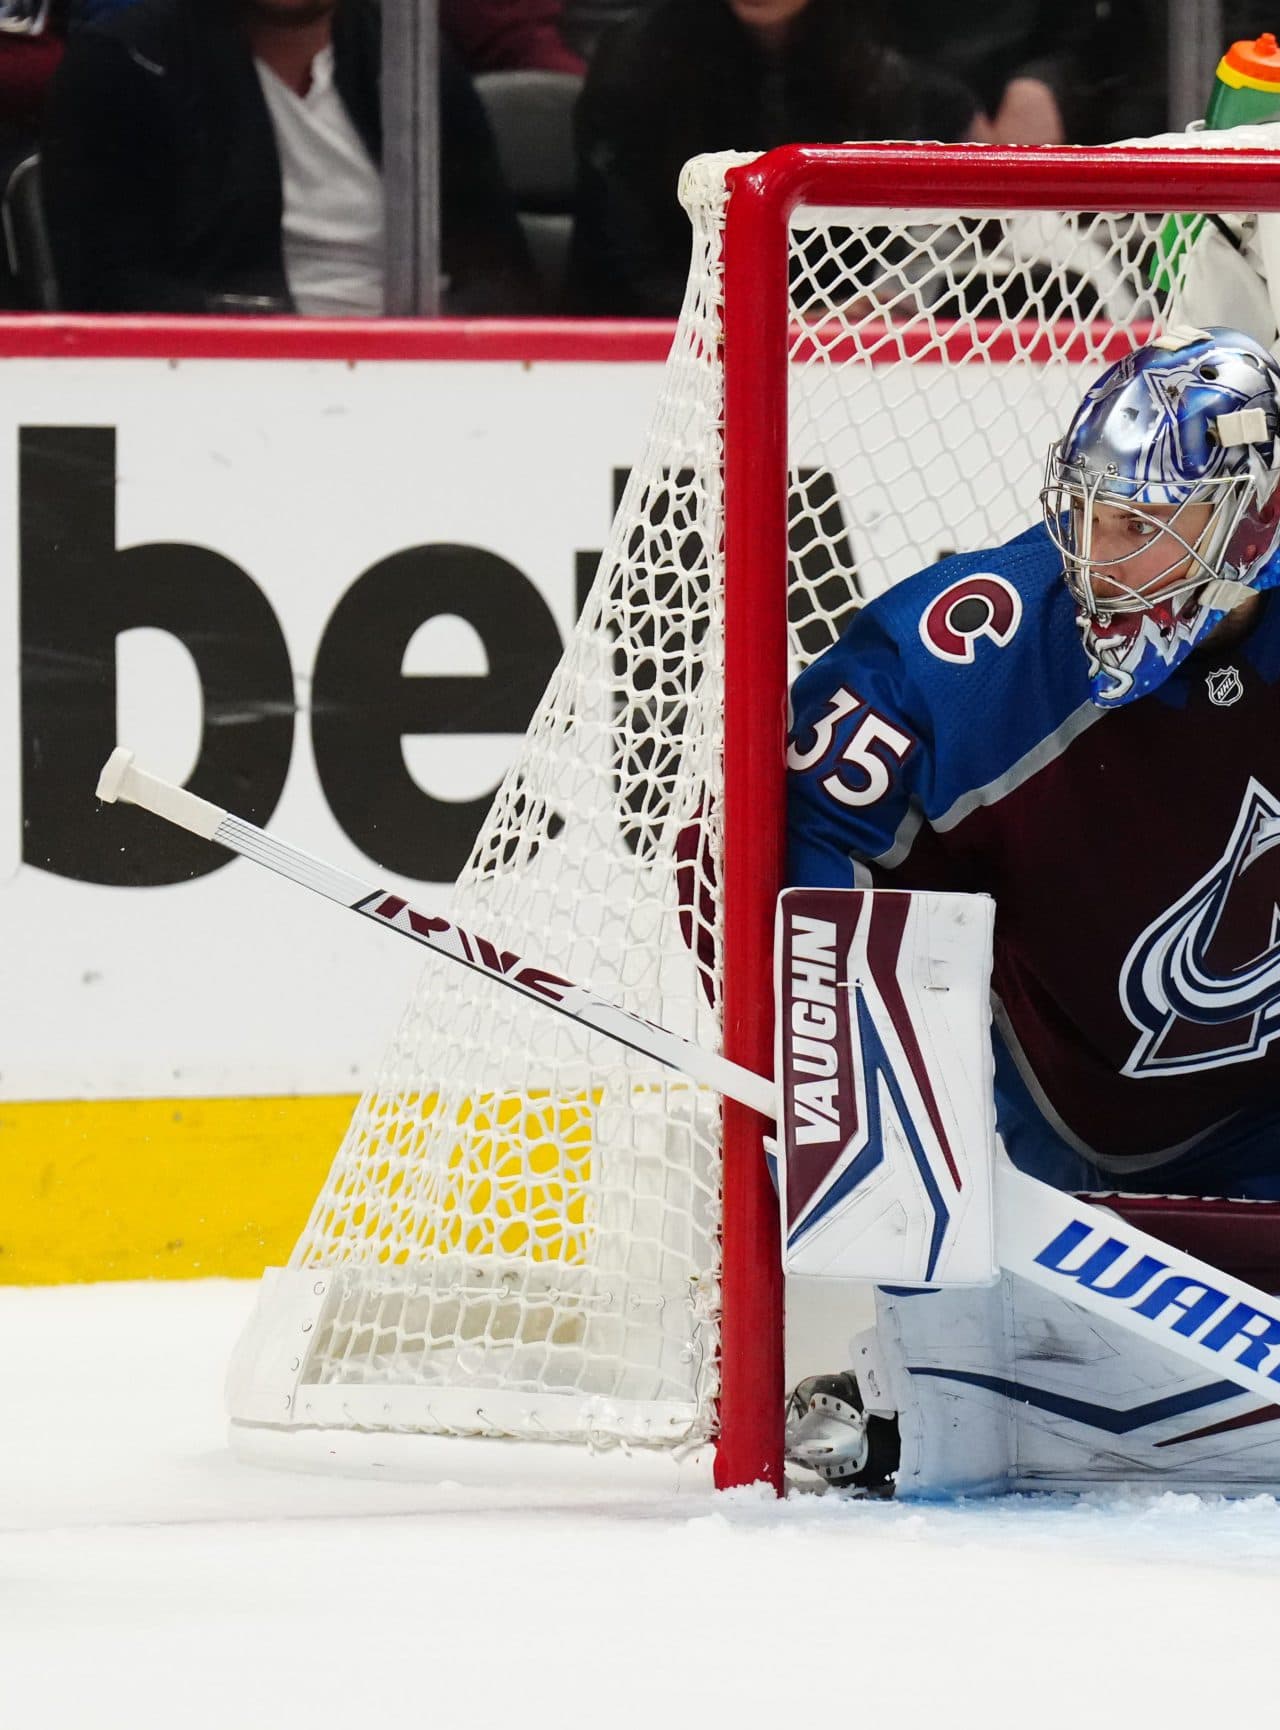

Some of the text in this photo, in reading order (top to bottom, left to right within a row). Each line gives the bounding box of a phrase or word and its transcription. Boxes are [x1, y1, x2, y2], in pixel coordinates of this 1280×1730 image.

[786, 686, 914, 808] 35
[1216, 677, 1235, 700] NHL
[791, 915, 841, 1145] VAUGHN
